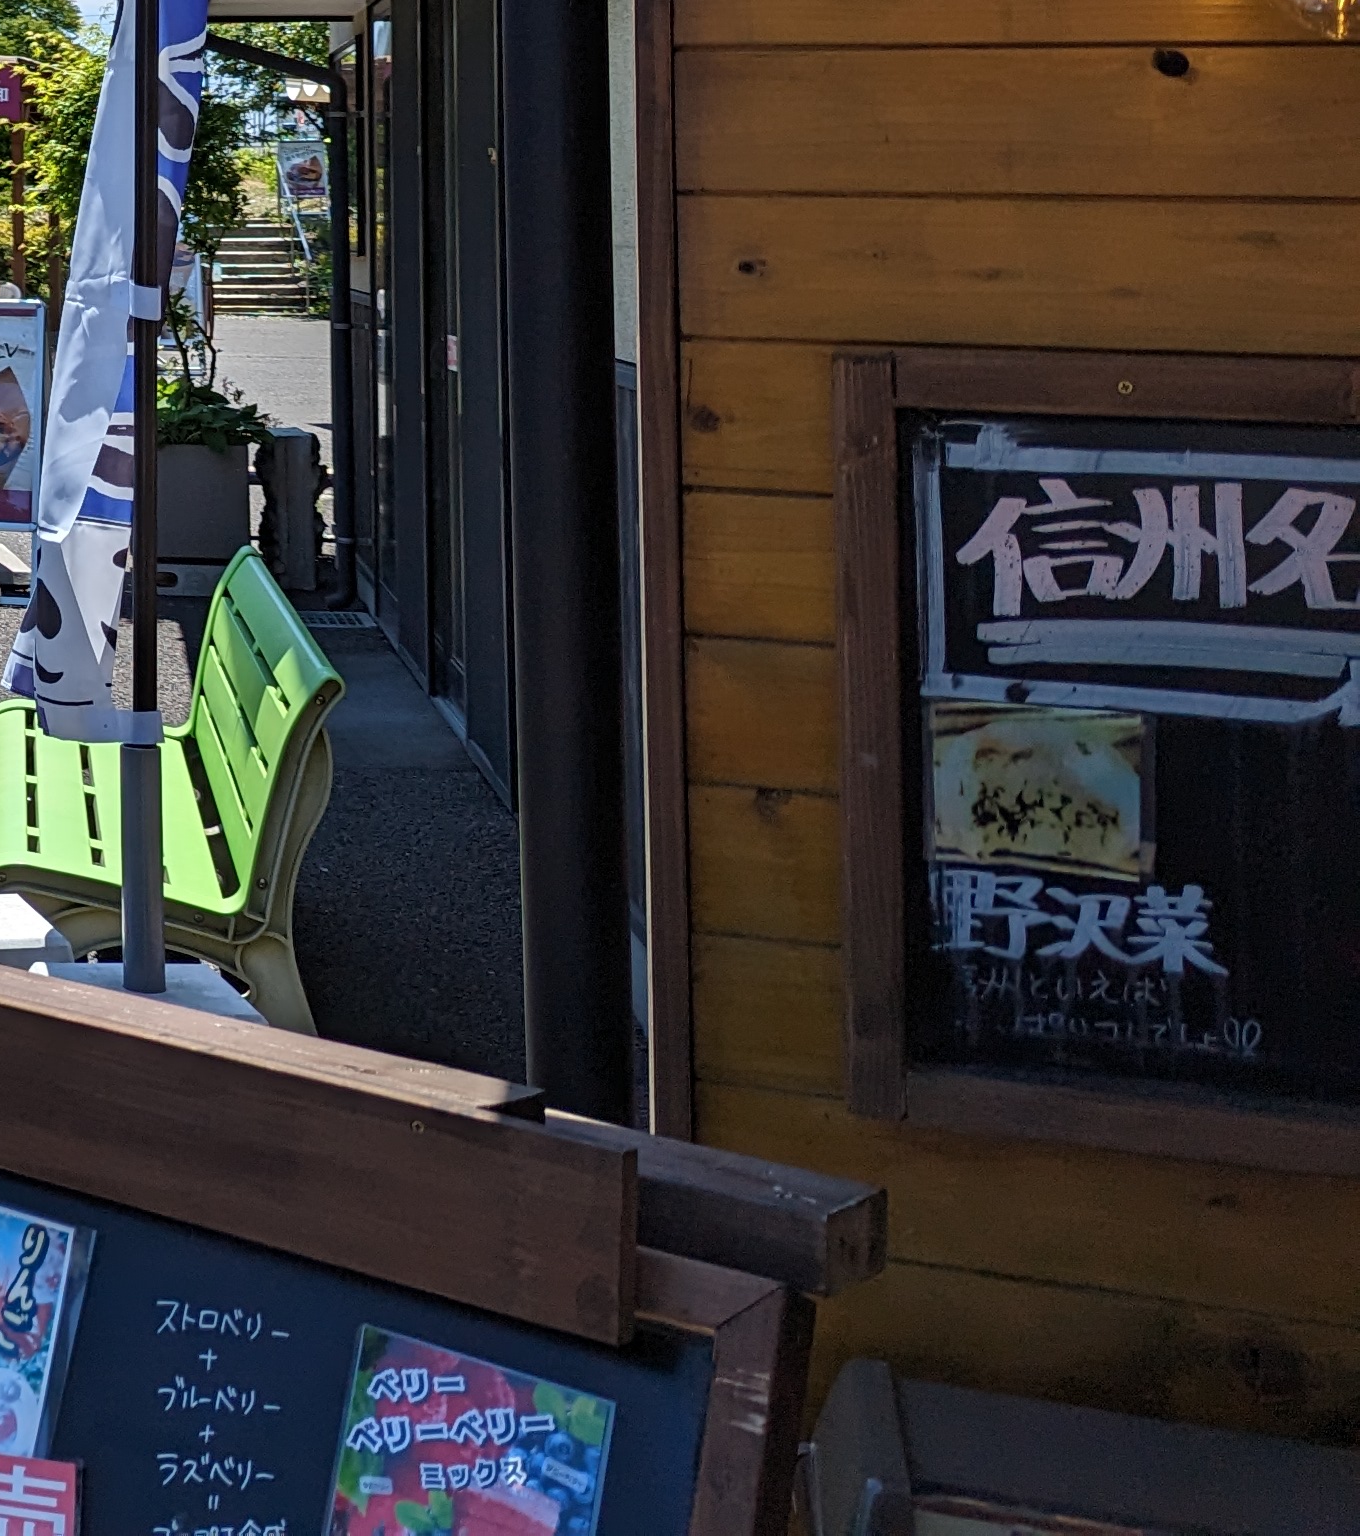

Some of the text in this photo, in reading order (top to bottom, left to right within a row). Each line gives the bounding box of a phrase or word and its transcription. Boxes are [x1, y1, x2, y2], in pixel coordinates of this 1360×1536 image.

[940, 869, 1228, 976] 野沢菜
[156, 1299, 290, 1340] ストロベリー
[157, 1374, 281, 1414] ブルーベリー
[367, 1368, 466, 1403] ベリー
[346, 1407, 556, 1454] ベリーベリー
[155, 1452, 276, 1488] ラズベリー
[420, 1456, 528, 1492] ミックス
